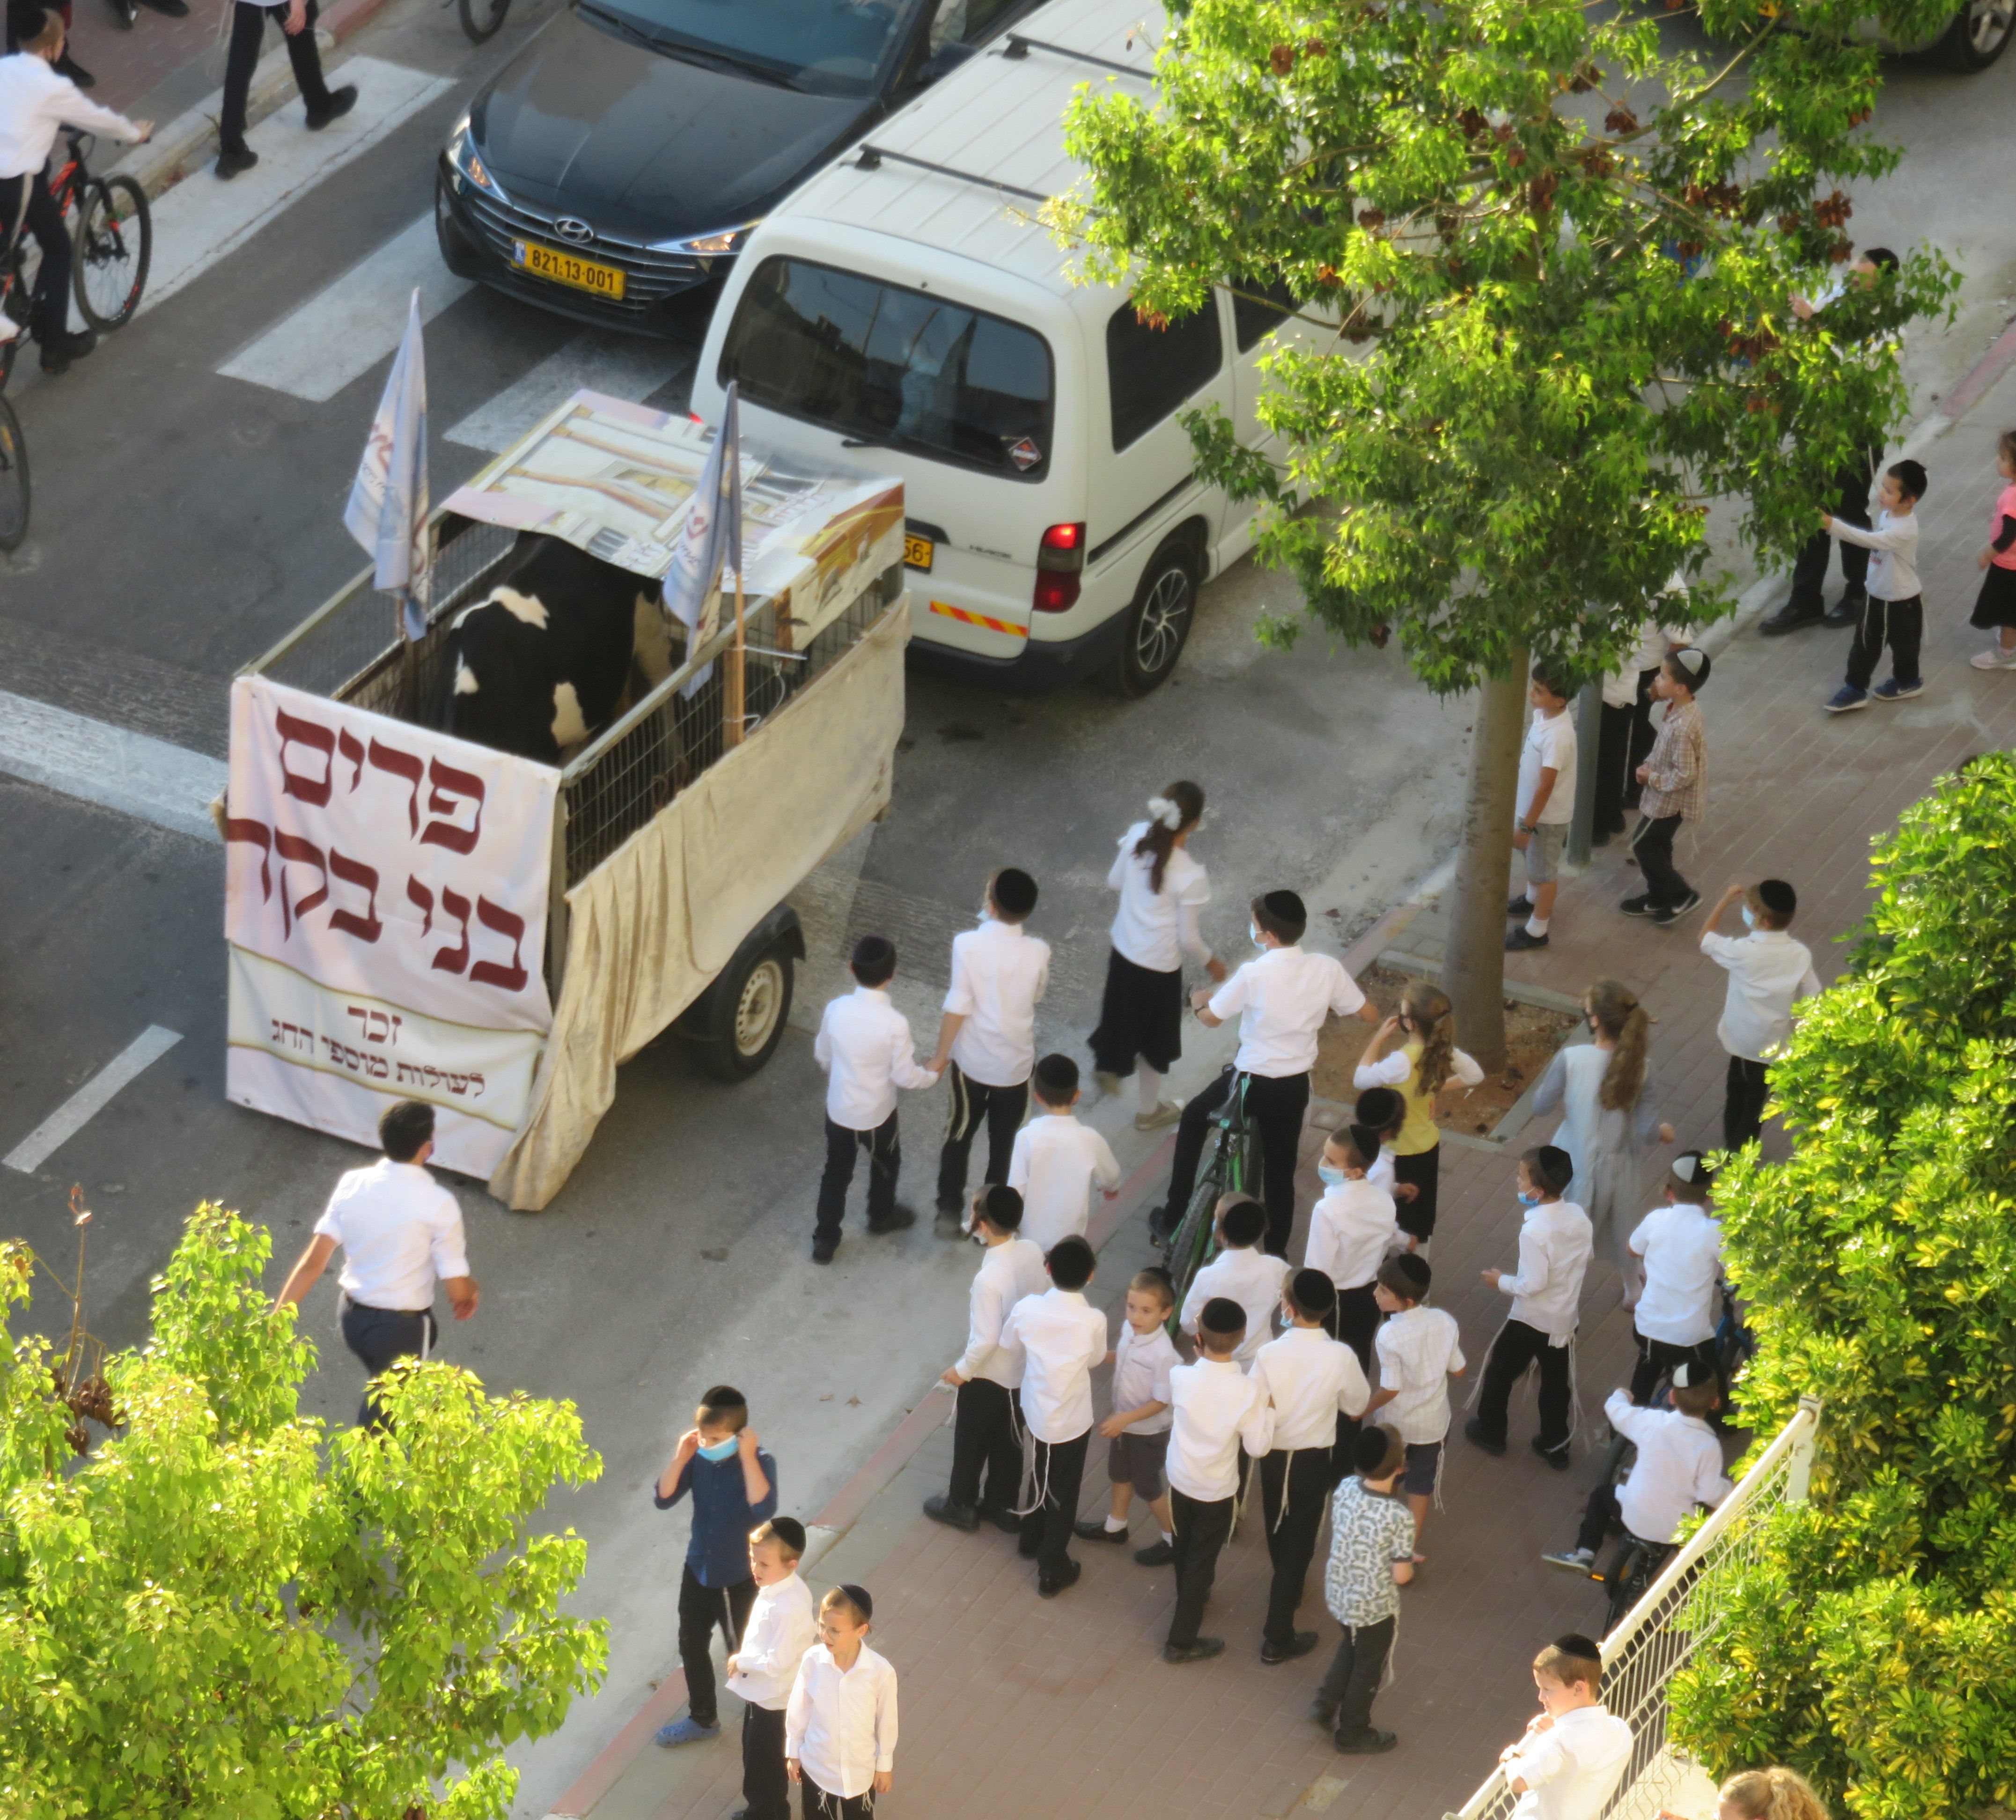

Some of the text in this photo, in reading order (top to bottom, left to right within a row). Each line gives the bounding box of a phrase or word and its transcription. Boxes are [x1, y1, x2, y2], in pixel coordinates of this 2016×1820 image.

[275, 706, 486, 855] פרים
[227, 818, 528, 992] בני בקר
[271, 1017, 486, 1098] לעולות מוספי החג
[348, 1005, 403, 1046] זכר
